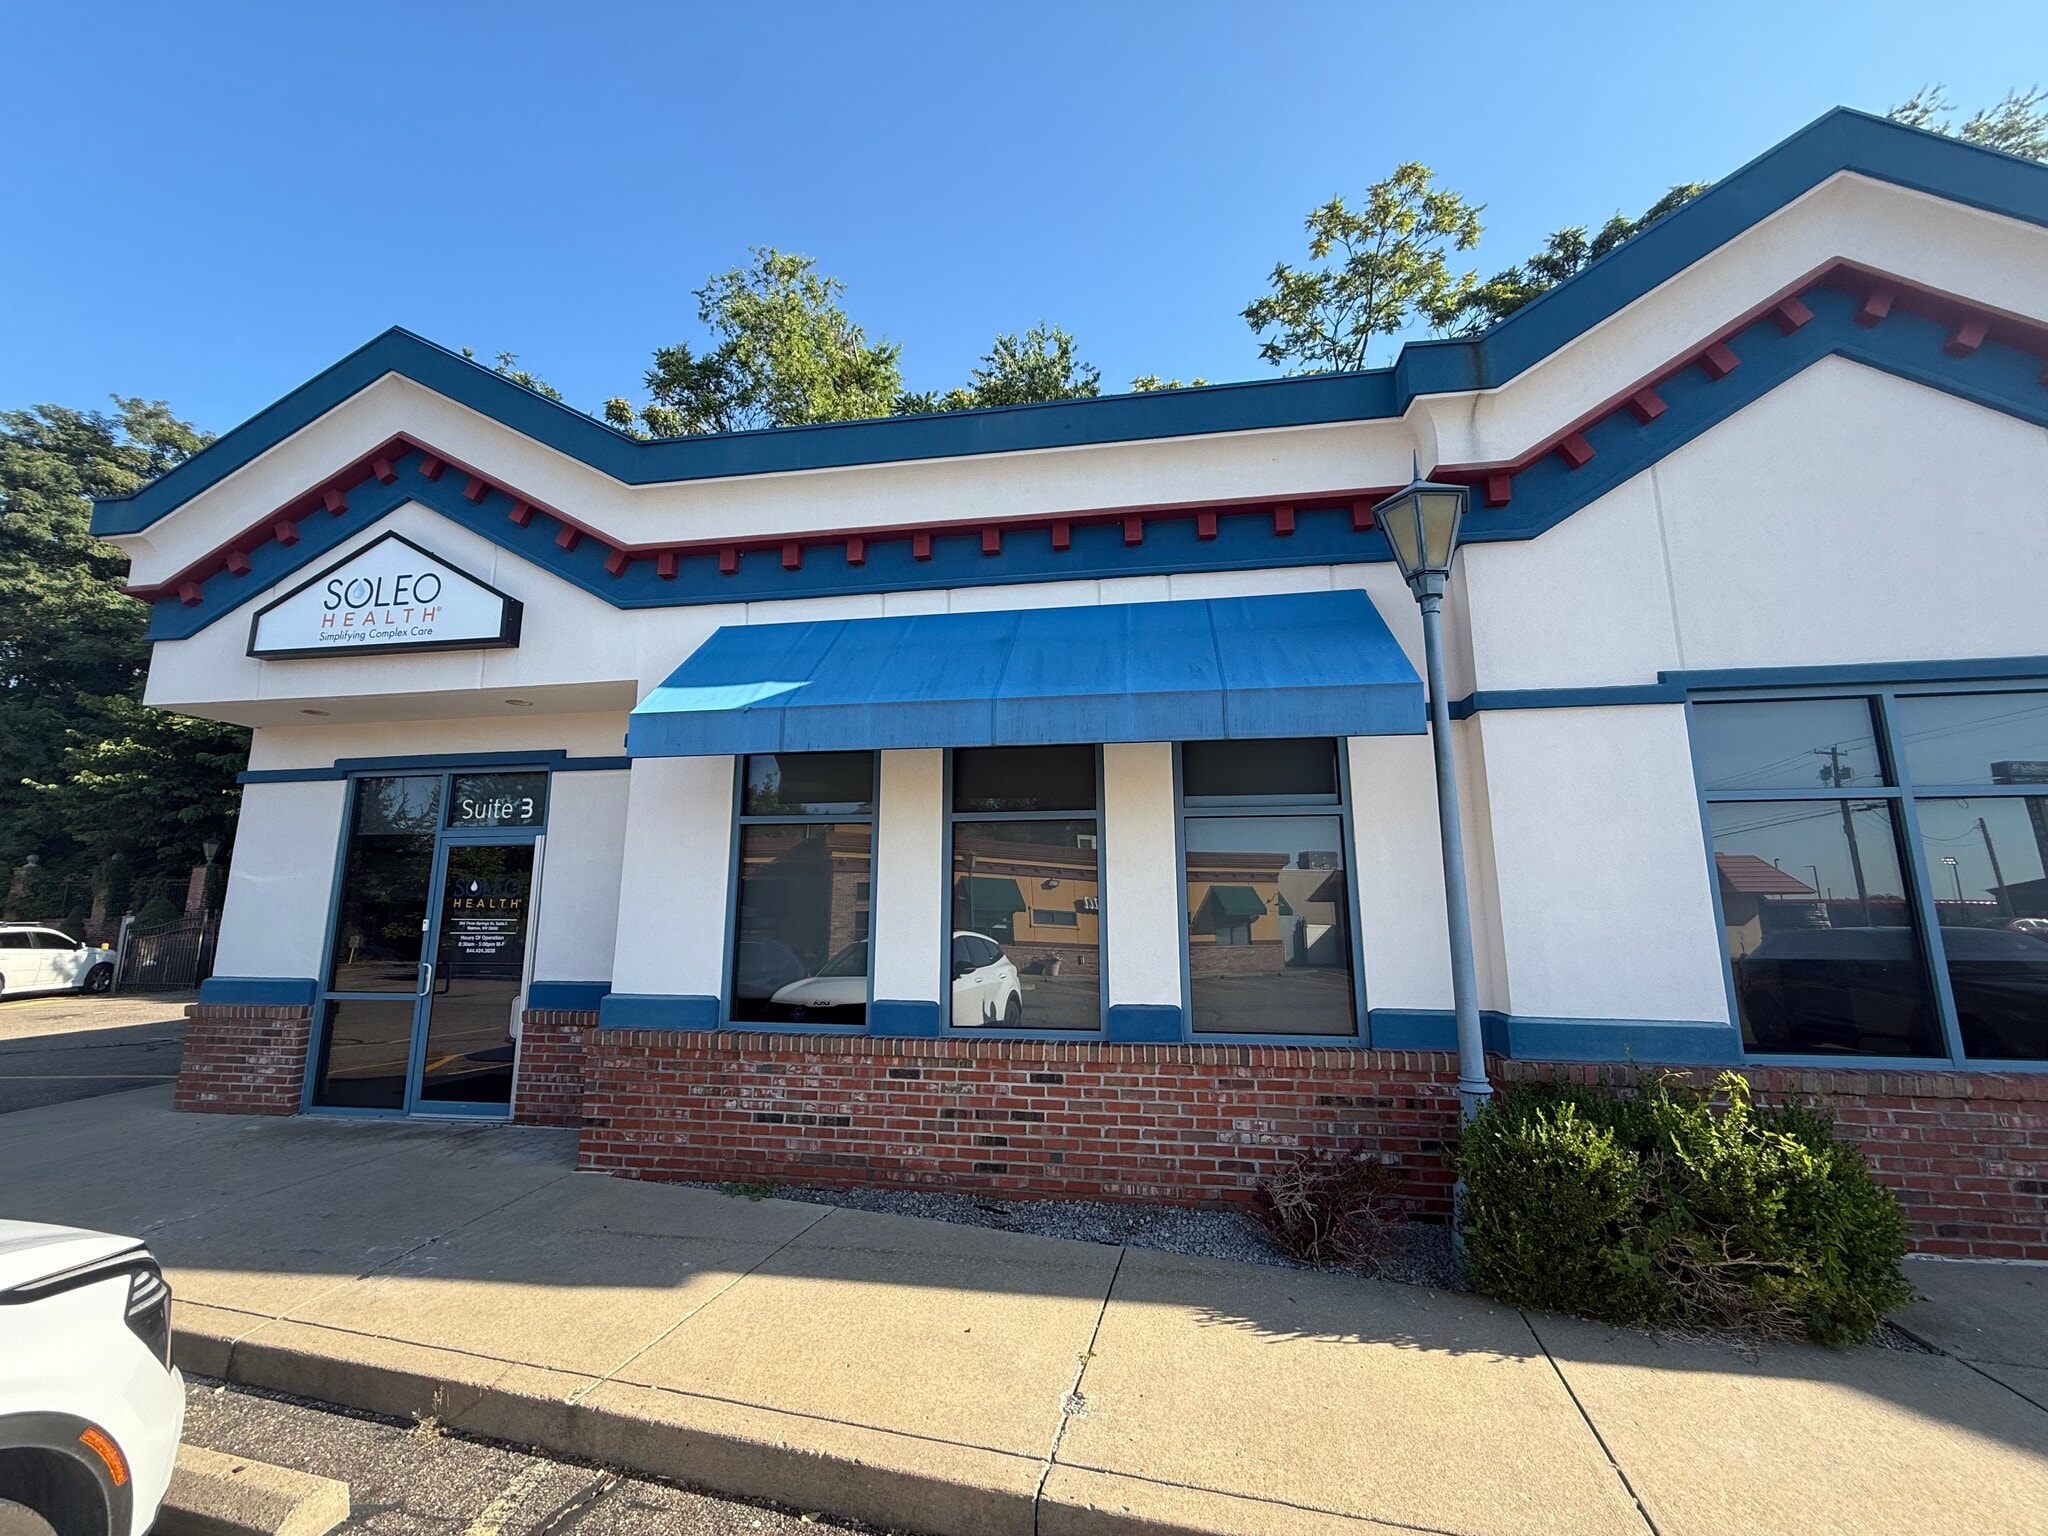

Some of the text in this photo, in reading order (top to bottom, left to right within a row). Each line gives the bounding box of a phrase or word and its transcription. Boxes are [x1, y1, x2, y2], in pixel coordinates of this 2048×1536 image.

[323, 572, 442, 610] SOLEO
[319, 626, 433, 643] Simplifying Complex Care
[462, 797, 534, 819] Suite 3
